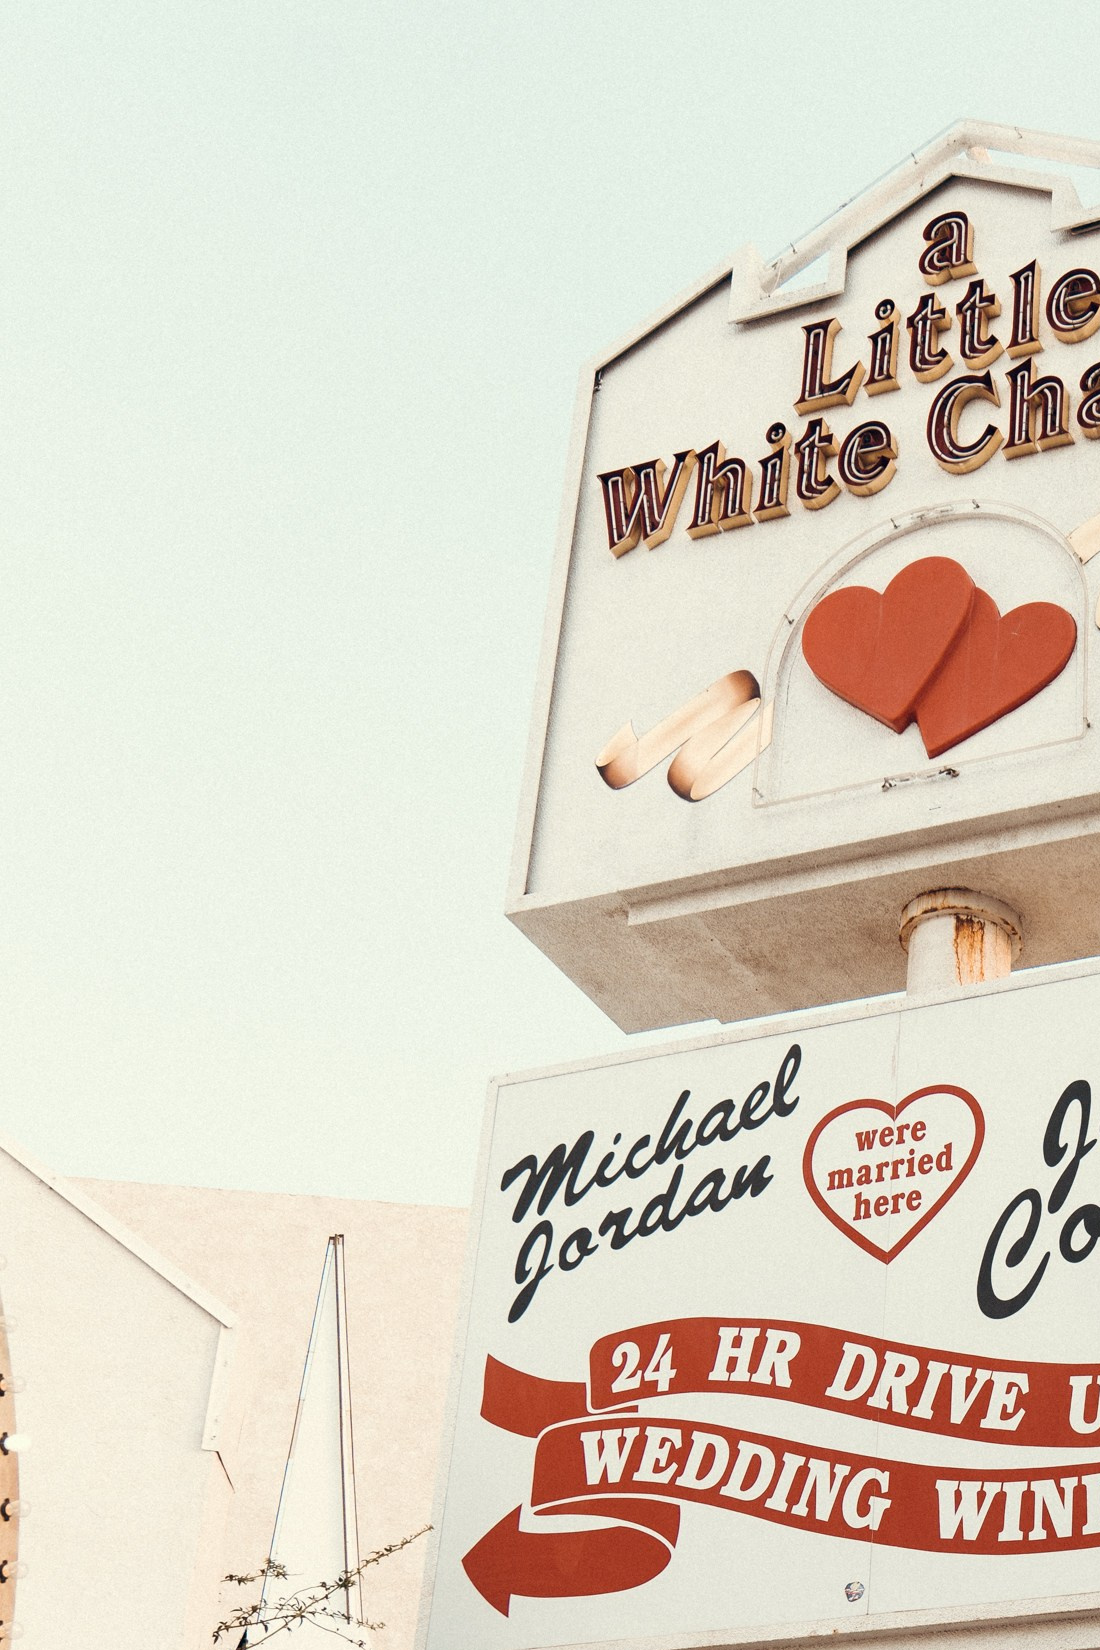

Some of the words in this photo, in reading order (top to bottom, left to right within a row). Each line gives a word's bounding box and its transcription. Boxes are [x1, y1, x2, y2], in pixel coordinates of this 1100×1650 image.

[918, 211, 979, 286] a
[596, 418, 899, 560] White
[500, 1043, 802, 1226] Michael
[827, 1142, 953, 1191] married
[855, 1120, 927, 1152] were
[507, 1154, 775, 1324] Jordan
[852, 1189, 922, 1221] here
[611, 1341, 677, 1394] 24
[708, 1327, 802, 1389] HR
[825, 1346, 1030, 1432] DRIVE
[579, 1429, 892, 1531] WEDDING
